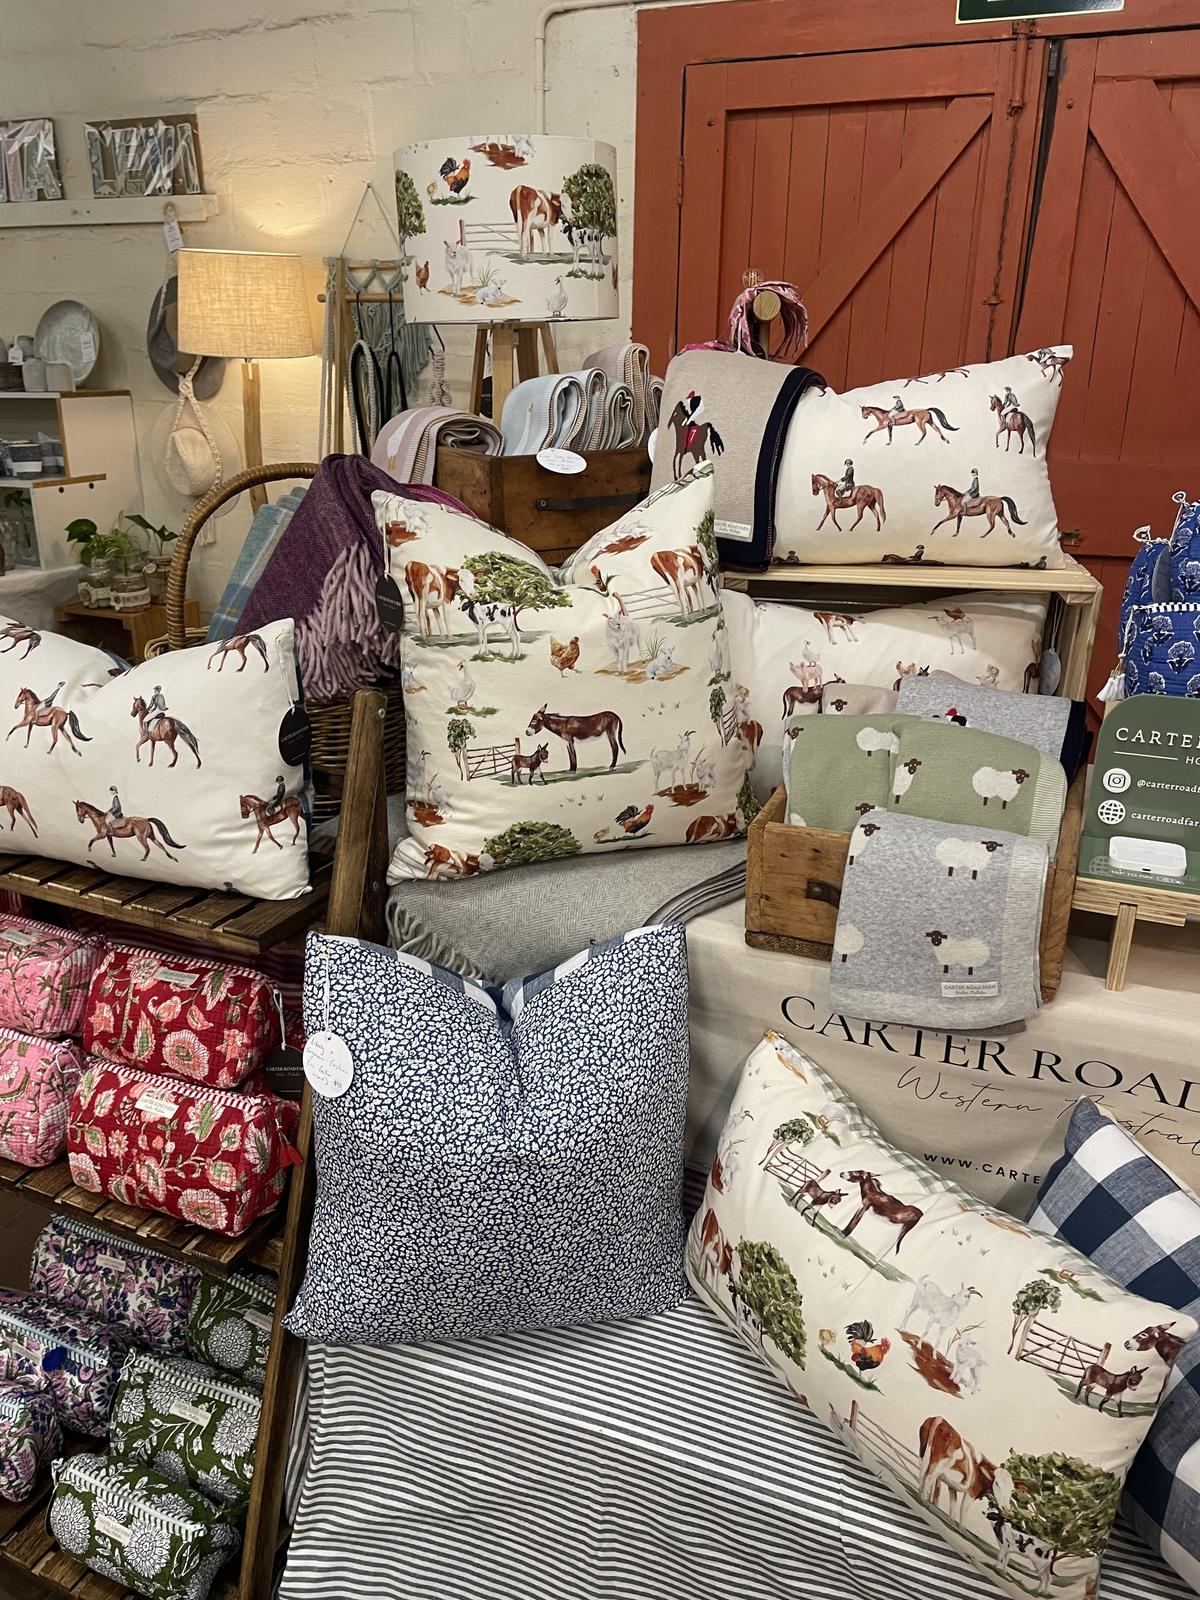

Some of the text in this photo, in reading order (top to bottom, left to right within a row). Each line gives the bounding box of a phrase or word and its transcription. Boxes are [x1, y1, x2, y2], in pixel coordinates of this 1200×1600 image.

[690, 429, 697, 443] 7
[1115, 727, 1200, 749] CARTE
[1131, 812, 1200, 828] carterroadfar
[780, 995, 1017, 1077] CARTER
[897, 1066, 1042, 1112] Western
